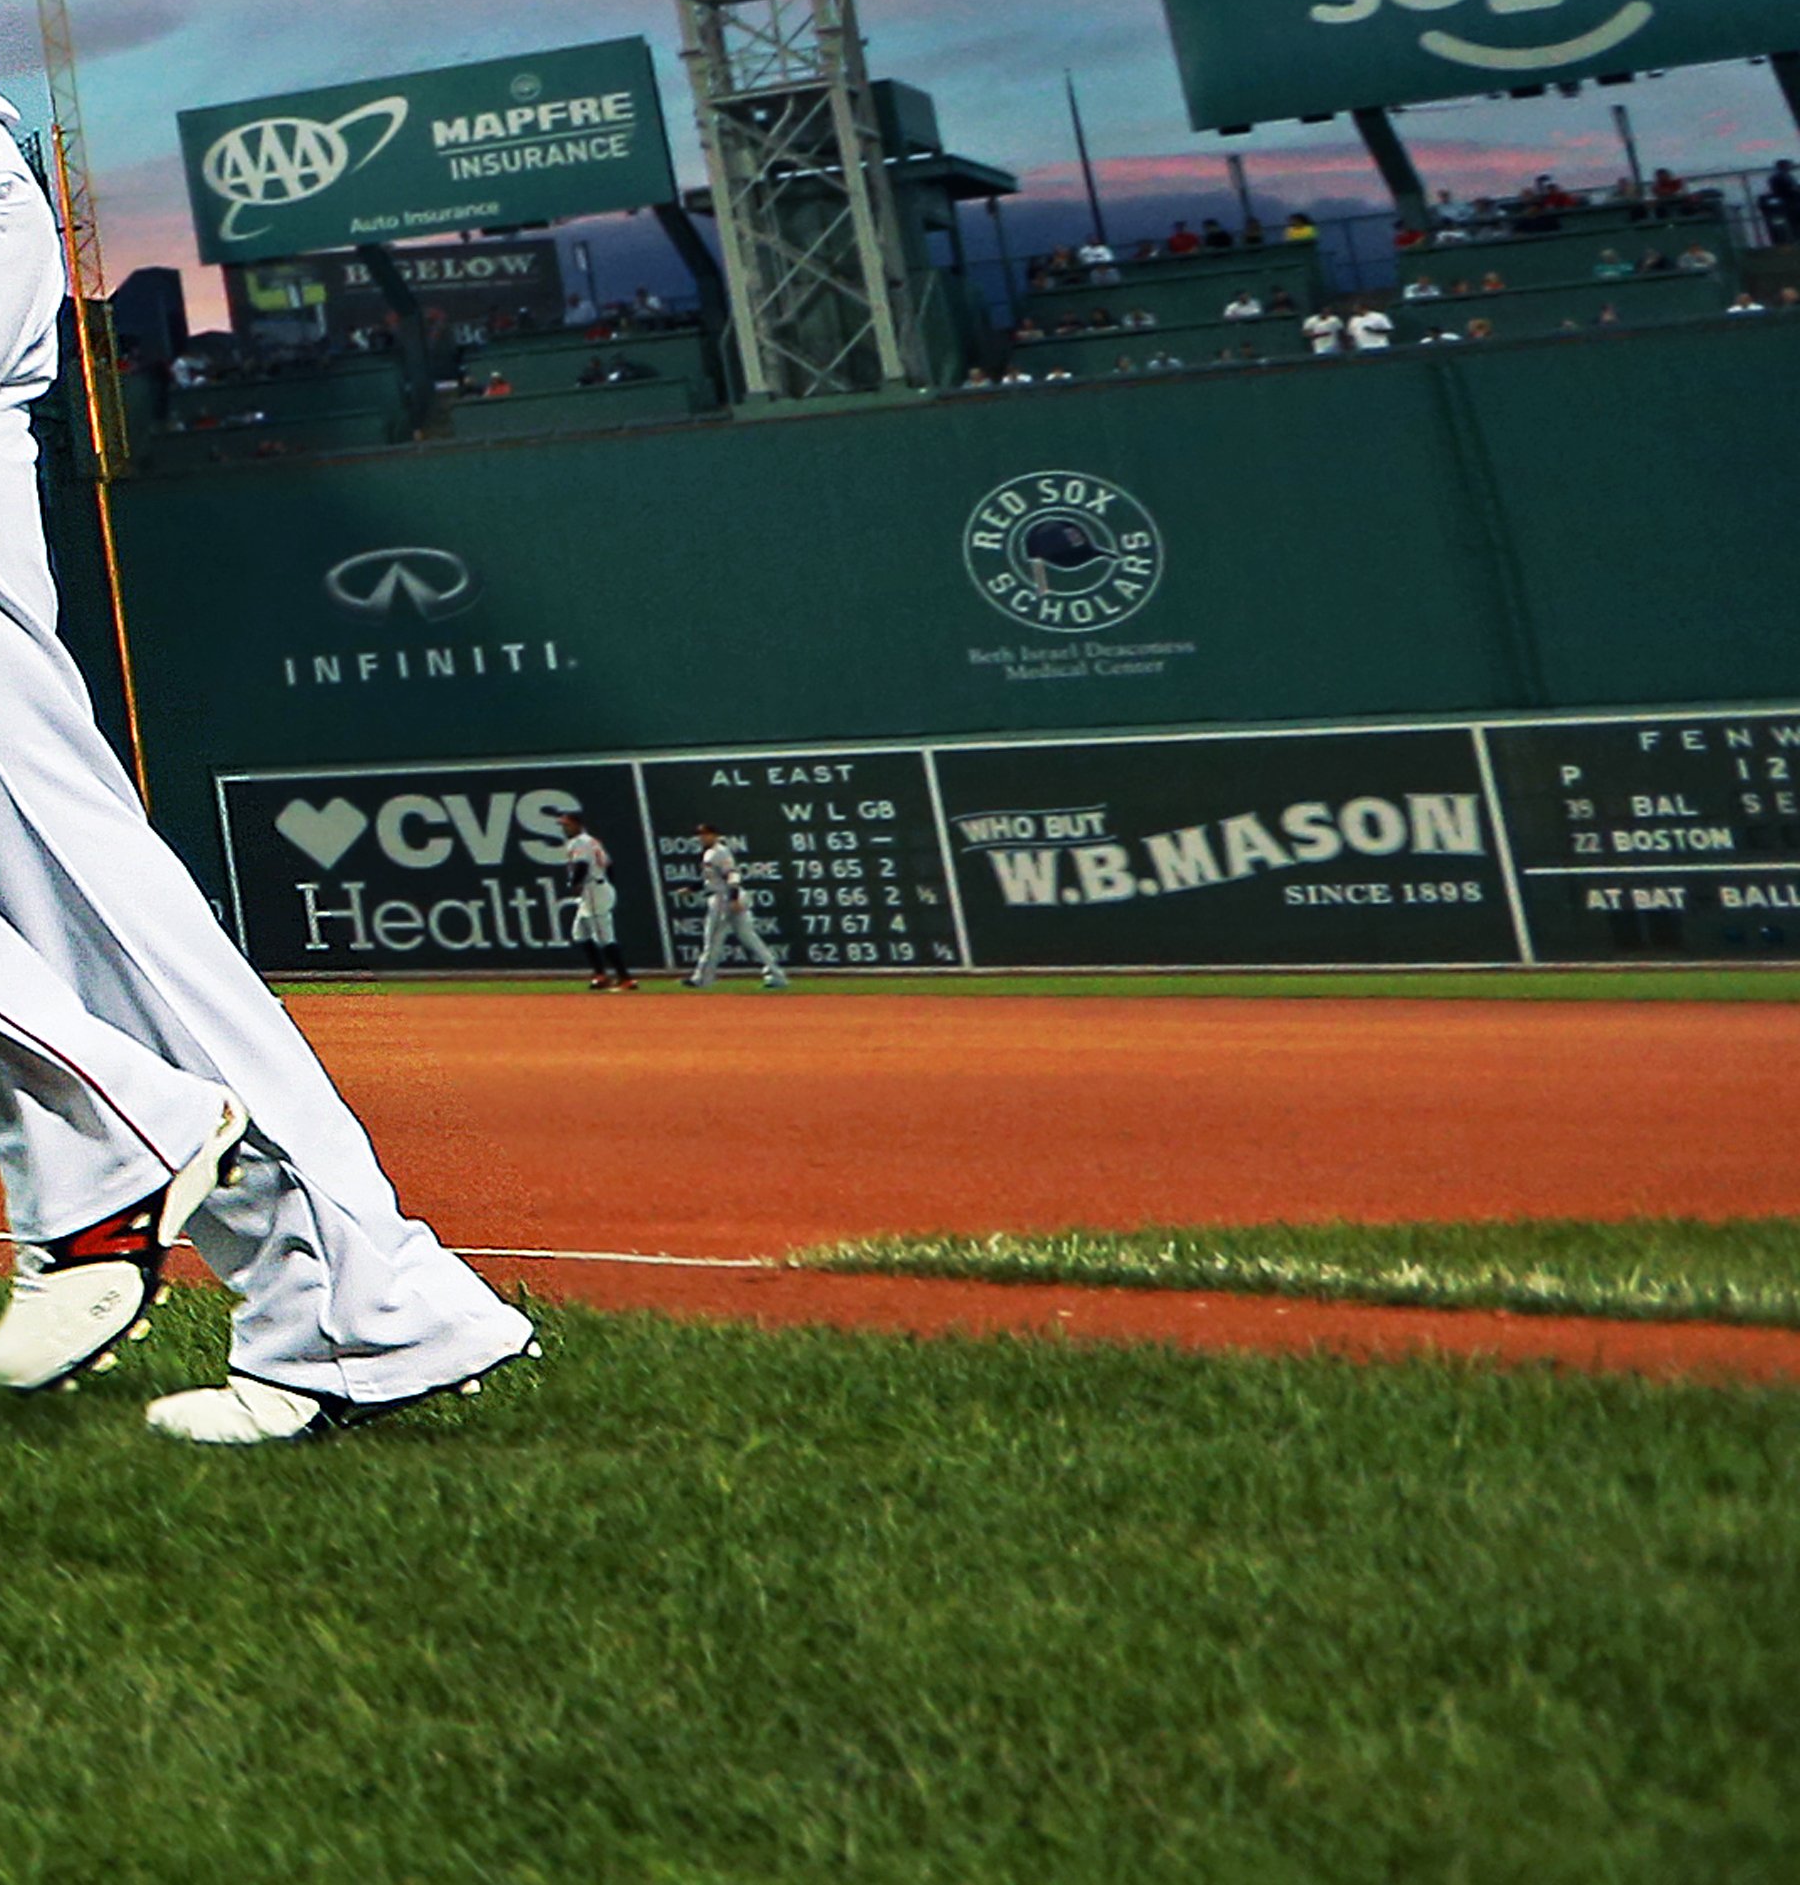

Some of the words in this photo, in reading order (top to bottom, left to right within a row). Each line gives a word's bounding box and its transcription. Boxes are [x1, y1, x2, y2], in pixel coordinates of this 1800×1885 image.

[432, 92, 634, 149] MAPFRE
[210, 120, 342, 202] AAA
[450, 135, 630, 181] INSURANCE
[350, 211, 399, 233] Auto
[403, 201, 500, 225] Insurance
[346, 253, 536, 283] BGELOW
[972, 491, 1027, 549] RED
[1038, 479, 1116, 514] SOX
[988, 531, 1152, 623] SCHOLARS
[970, 646, 1016, 664] Beth
[1021, 643, 1078, 661] Israel
[1084, 641, 1195, 658] Deaconess
[1006, 660, 1088, 679] Medical
[1094, 660, 1165, 676] Center
[711, 769, 751, 787] AL
[766, 764, 854, 785] EAST
[1561, 765, 1581, 787] P
[1767, 757, 1790, 780] 2
[781, 802, 813, 822] W
[826, 803, 846, 821] L
[858, 800, 896, 821] GB
[1631, 794, 1700, 817] BAL
[375, 788, 583, 870] CVS
[959, 816, 1037, 845] WHO
[1044, 811, 1107, 839] BUT
[1611, 827, 1735, 852] BOSTON
[826, 831, 858, 851] 63
[791, 859, 824, 879] 79
[831, 858, 863, 877] 65
[879, 857, 897, 877] 2
[798, 887, 830, 907] 79
[836, 887, 869, 907] 66
[884, 886, 901, 906] 2
[1284, 883, 1392, 905] SINCE
[1402, 881, 1483, 904] 1898
[1586, 888, 1622, 910] AT
[1631, 886, 1686, 910] BAT
[295, 878, 584, 951] Health
[802, 915, 832, 934] 77
[841, 914, 871, 934] 67
[890, 913, 907, 933] 4
[808, 944, 839, 963] 62
[889, 942, 916, 961] 19
